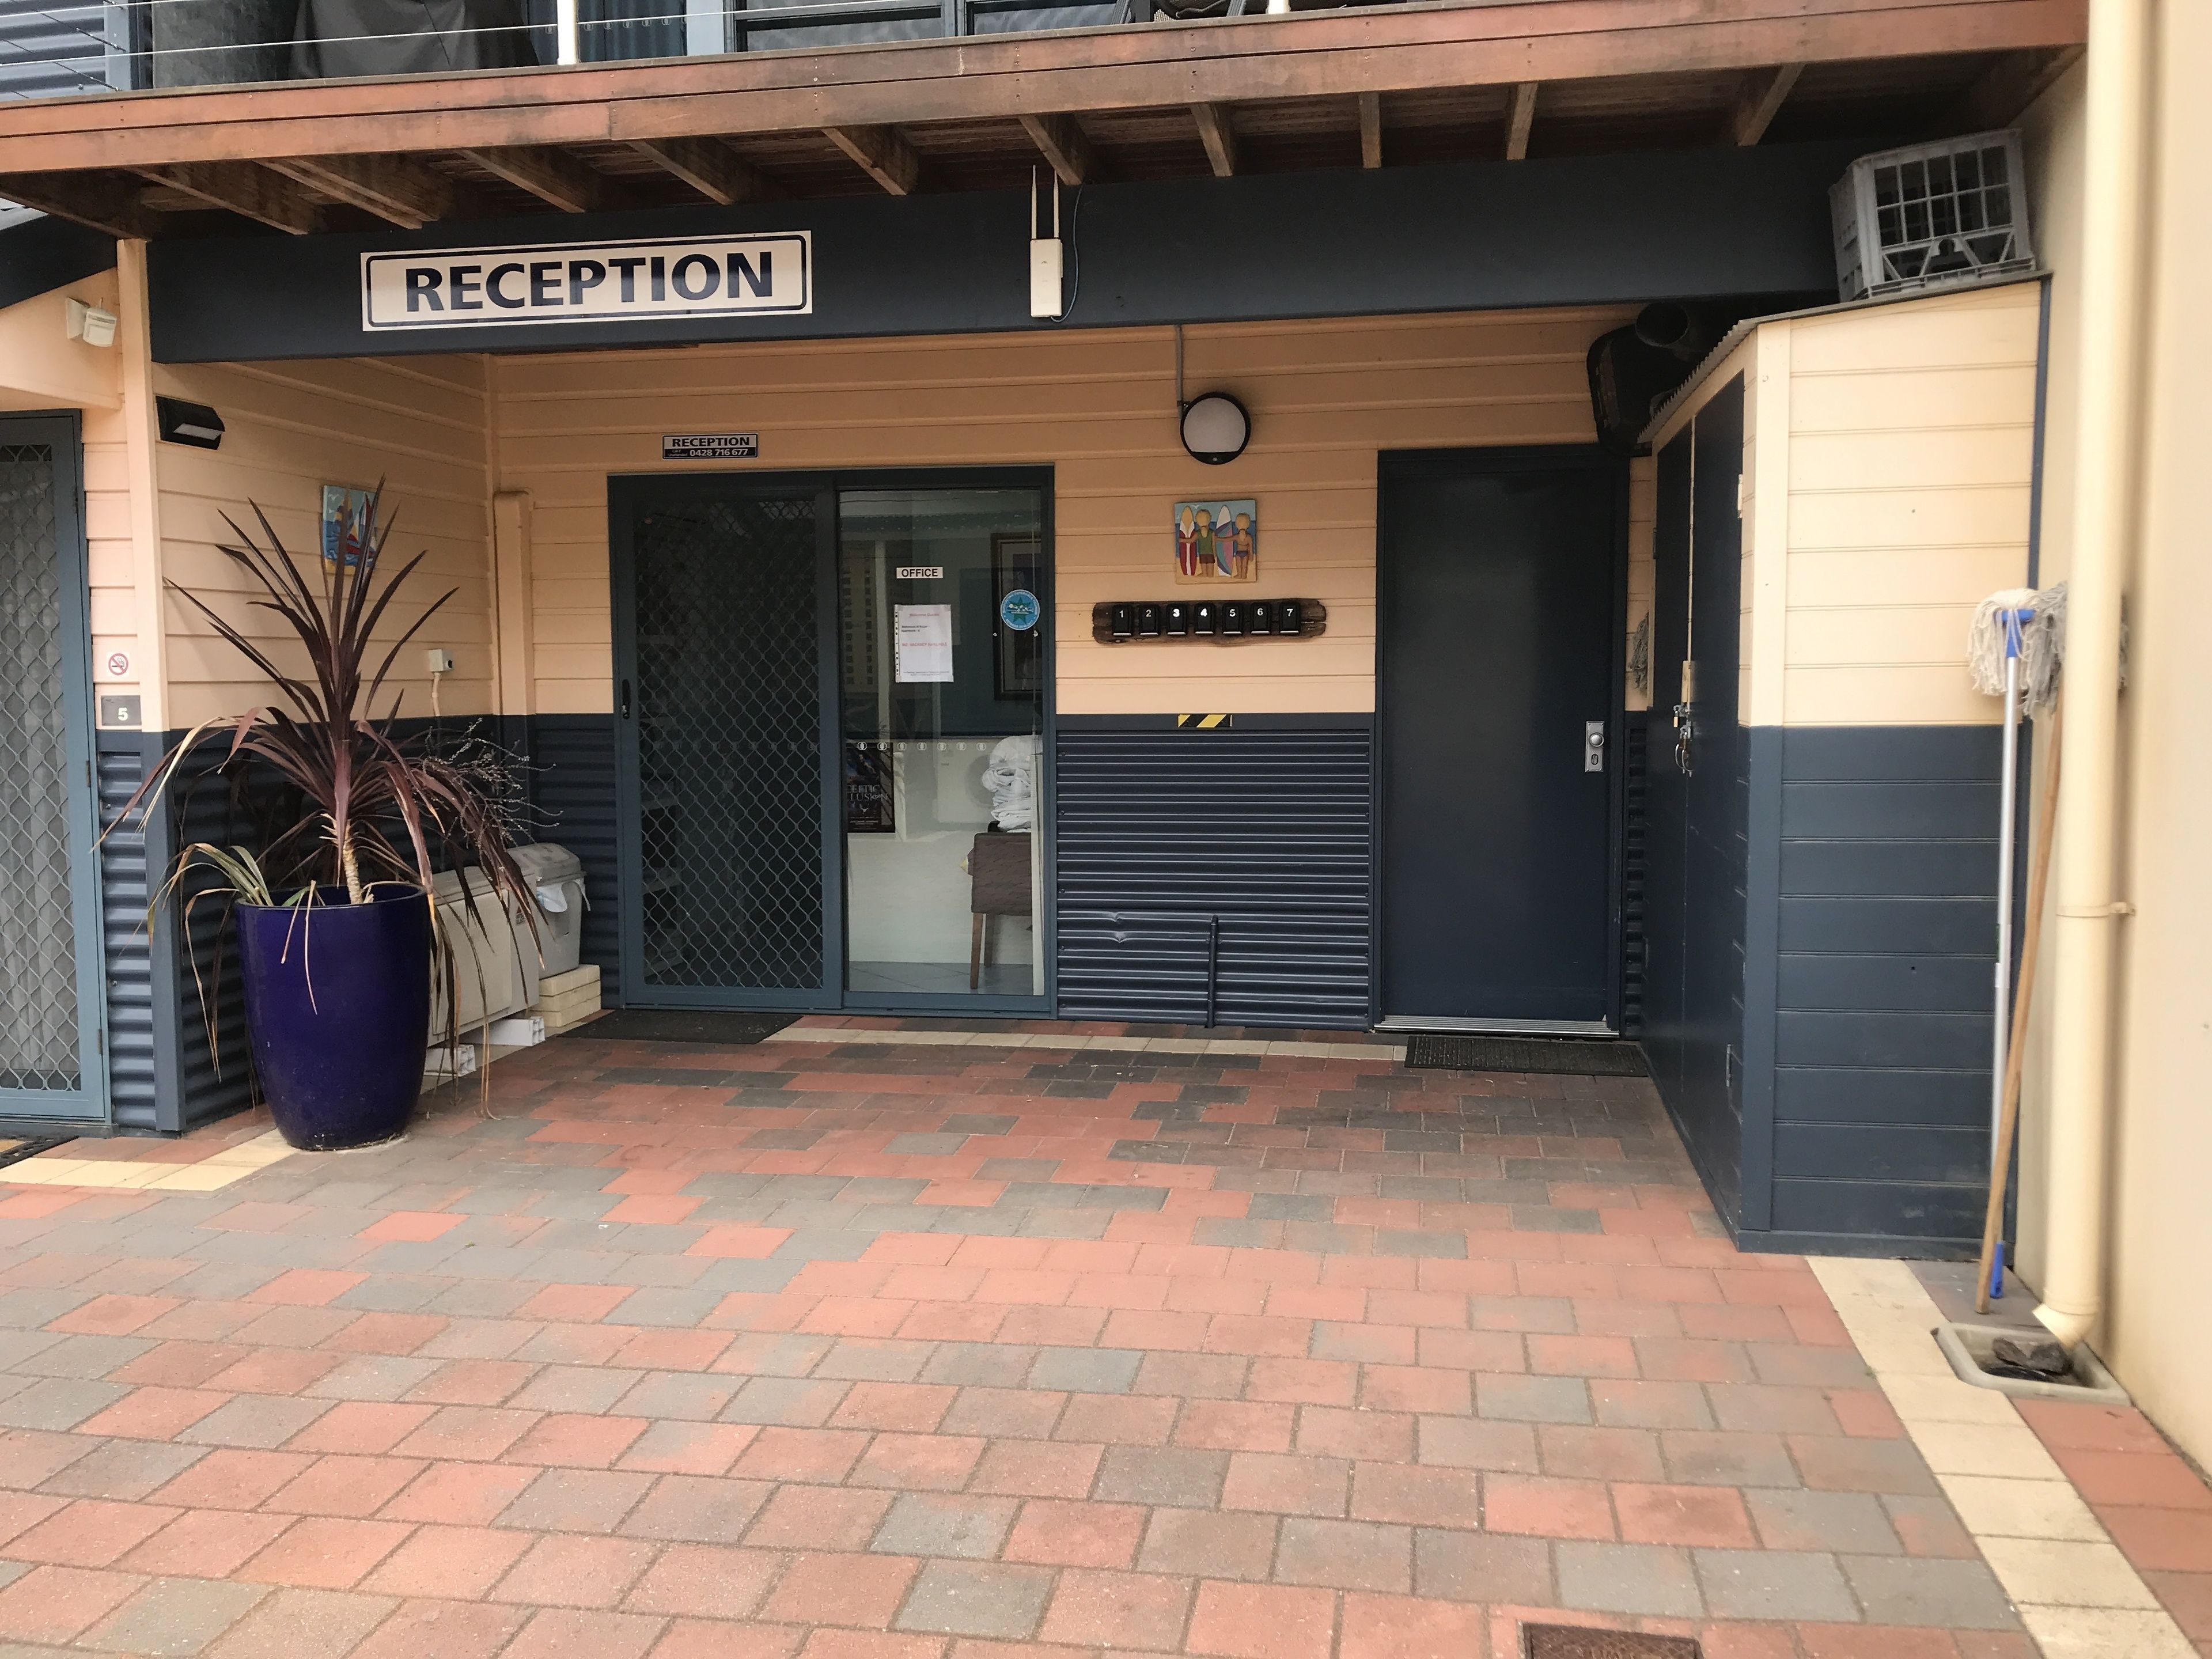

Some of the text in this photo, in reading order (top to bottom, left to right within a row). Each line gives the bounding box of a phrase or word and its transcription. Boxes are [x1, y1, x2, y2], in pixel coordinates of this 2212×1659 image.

[406, 252, 772, 312] RECEPTION
[672, 437, 749, 447] RECEPTION
[901, 569, 938, 577] OFFICE
[1173, 609, 1180, 617] 3
[1200, 608, 1207, 616] 4
[1229, 609, 1236, 617] 5
[1257, 608, 1263, 616] 6
[1286, 608, 1293, 616] 7
[118, 707, 128, 721] 5
